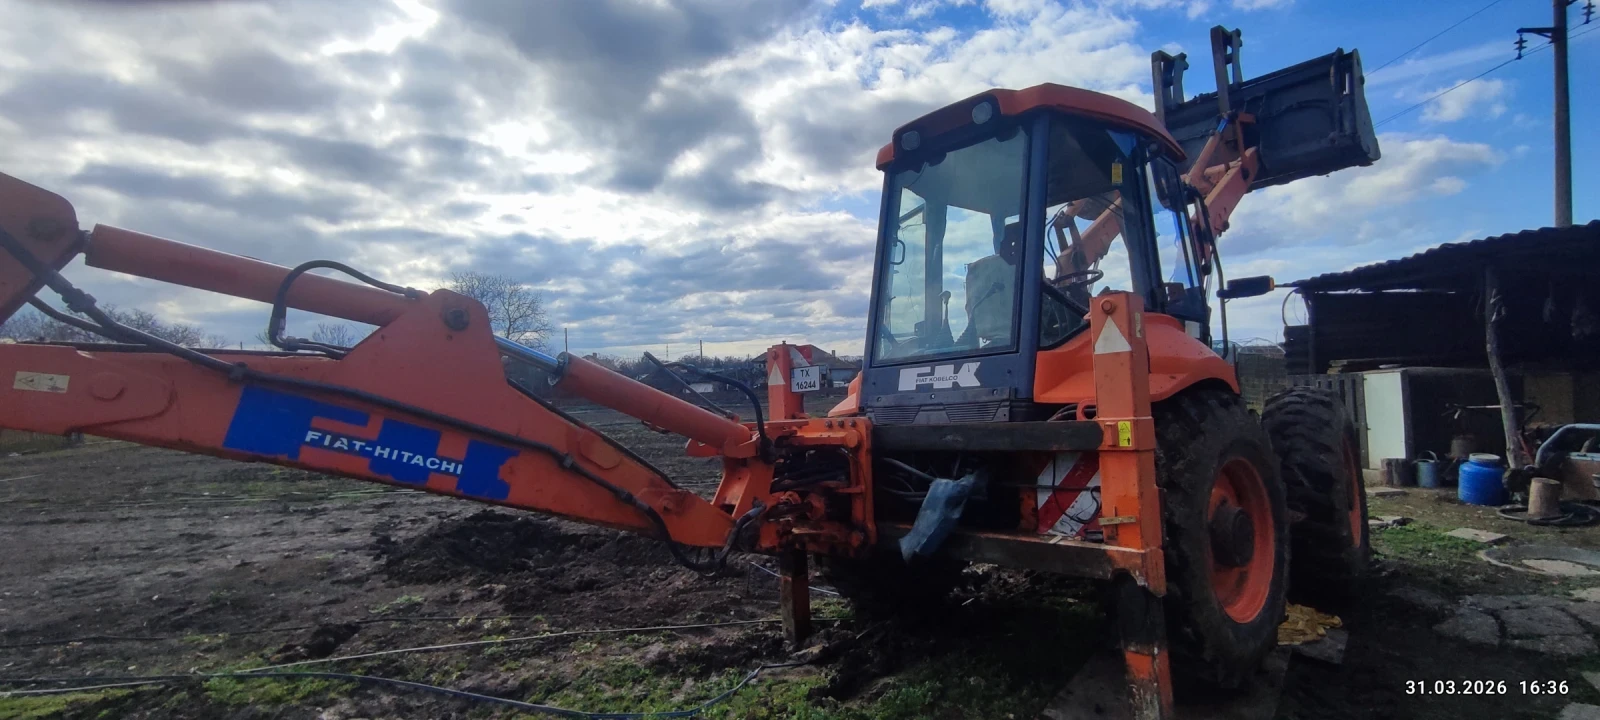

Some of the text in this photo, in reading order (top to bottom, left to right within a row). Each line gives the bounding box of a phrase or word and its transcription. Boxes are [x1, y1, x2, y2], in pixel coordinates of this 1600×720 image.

[800, 369, 810, 378] TX
[928, 375, 958, 383] KOBELCO
[795, 380, 816, 390] 16244
[304, 430, 463, 475] FIAT-HITACHI
